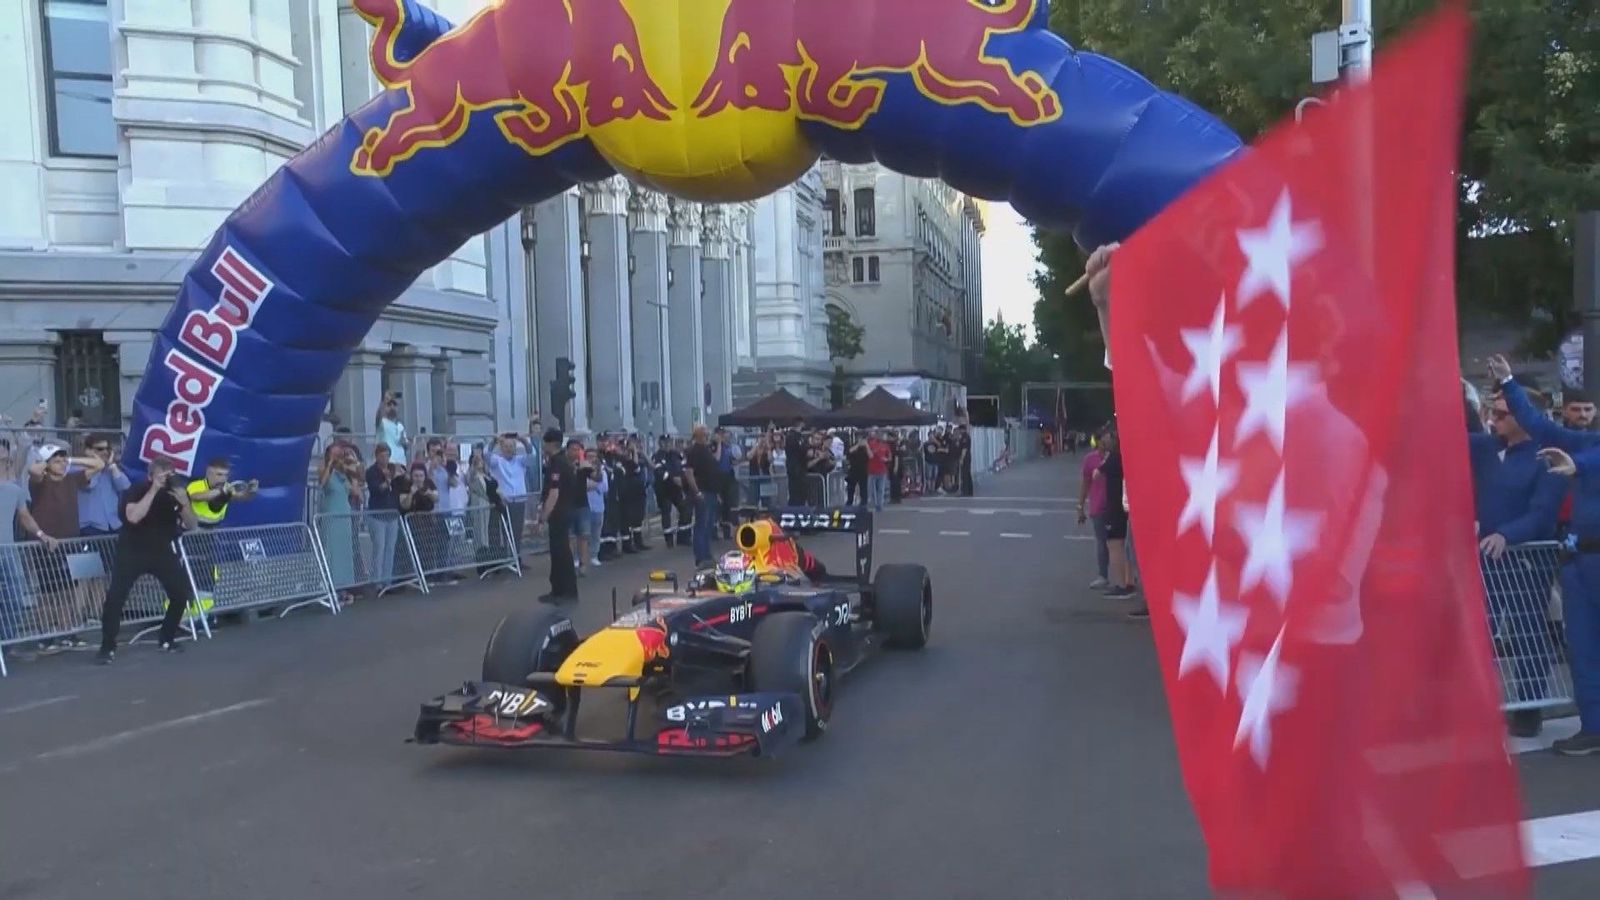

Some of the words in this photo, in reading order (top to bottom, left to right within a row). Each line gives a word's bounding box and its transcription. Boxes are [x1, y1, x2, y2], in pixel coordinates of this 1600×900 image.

[179, 247, 272, 368] Bull
[140, 350, 222, 476] Red
[730, 601, 753, 624] BYBIT
